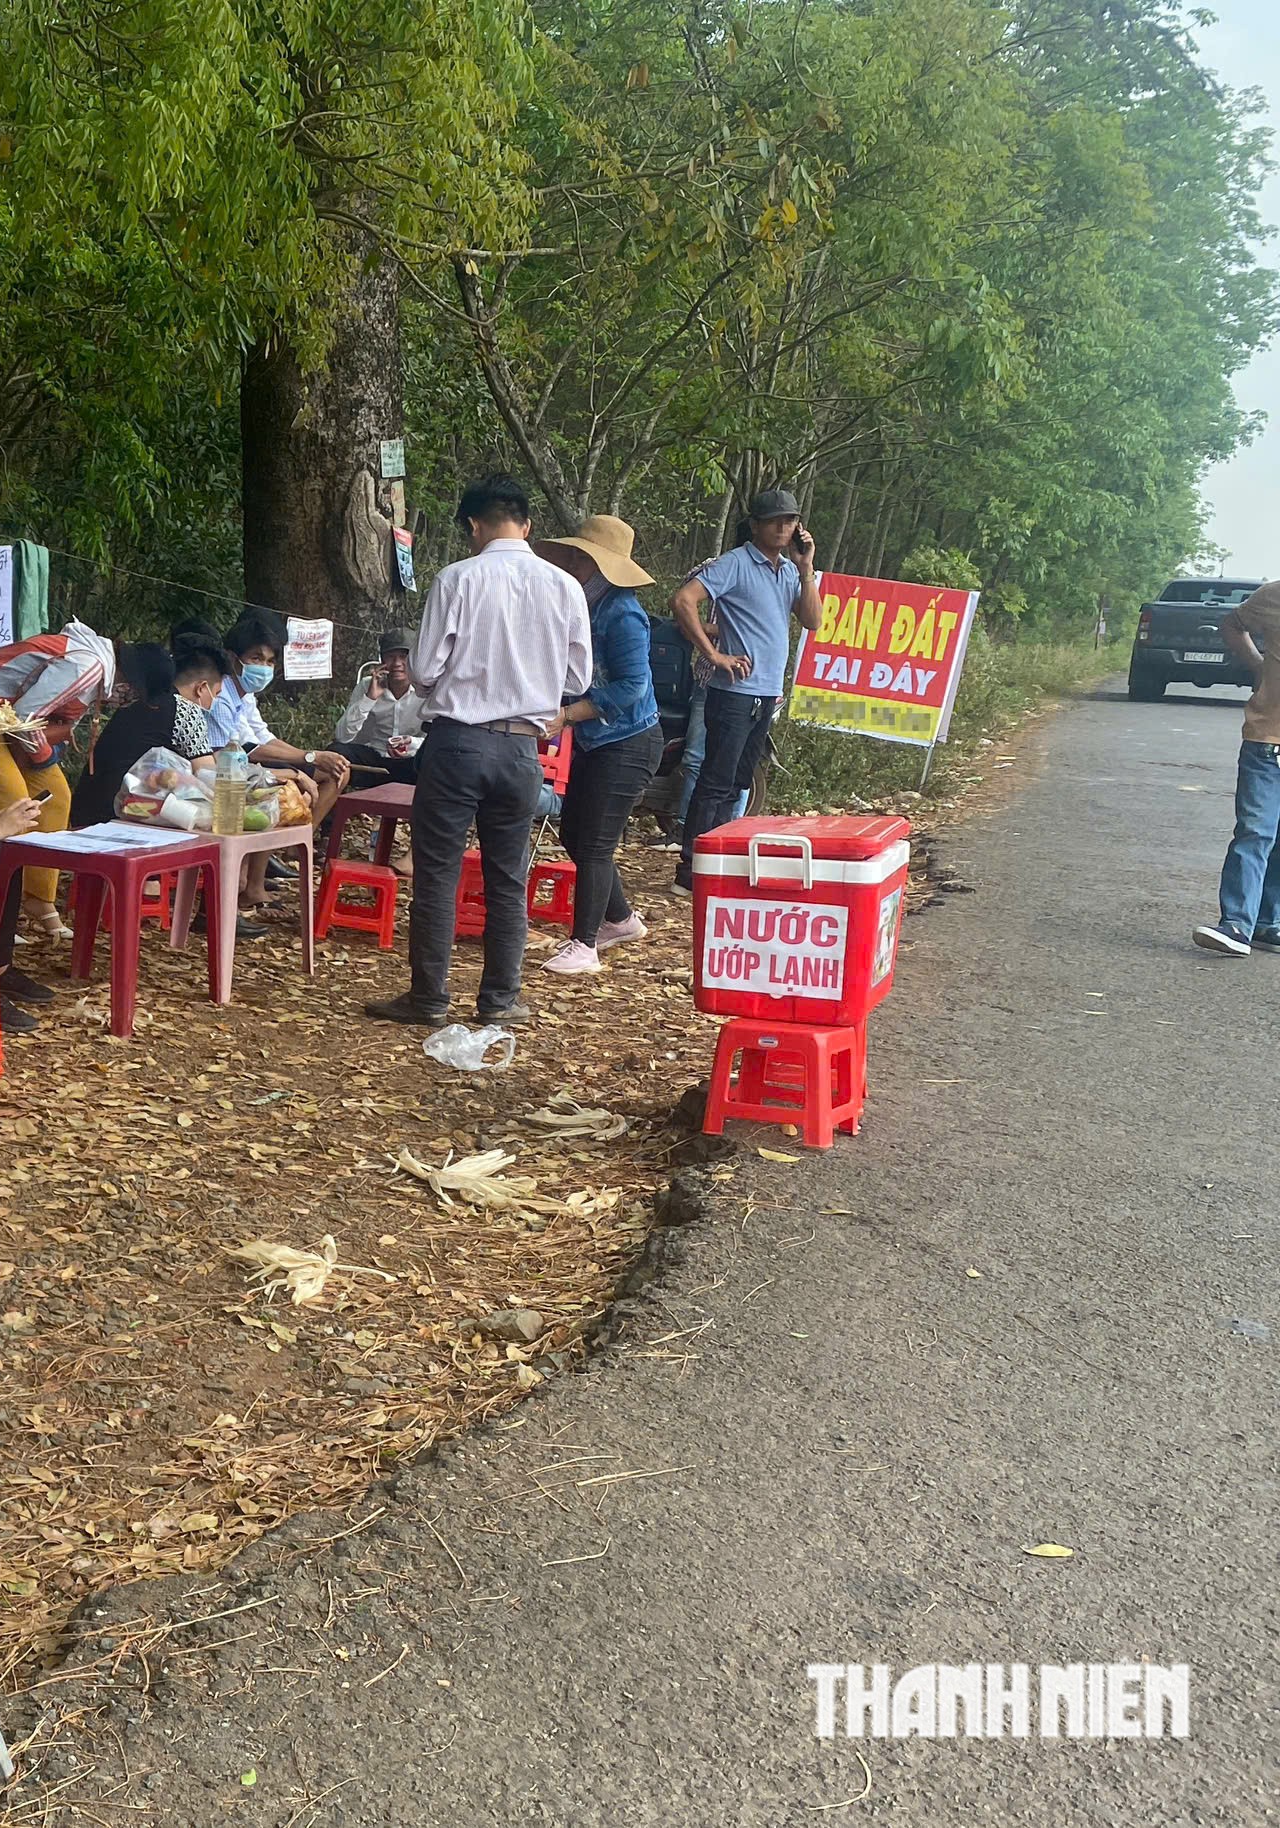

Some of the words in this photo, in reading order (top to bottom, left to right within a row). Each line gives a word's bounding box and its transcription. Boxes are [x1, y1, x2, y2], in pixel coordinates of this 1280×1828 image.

[814, 586, 886, 651] BÁN
[888, 593, 958, 661] ĐẤT
[813, 653, 862, 689] TẠI
[869, 661, 937, 696] ĐÂY
[713, 906, 839, 948] NƯỚC
[708, 944, 761, 981] ƯỚP
[768, 954, 840, 992] LẠNH
